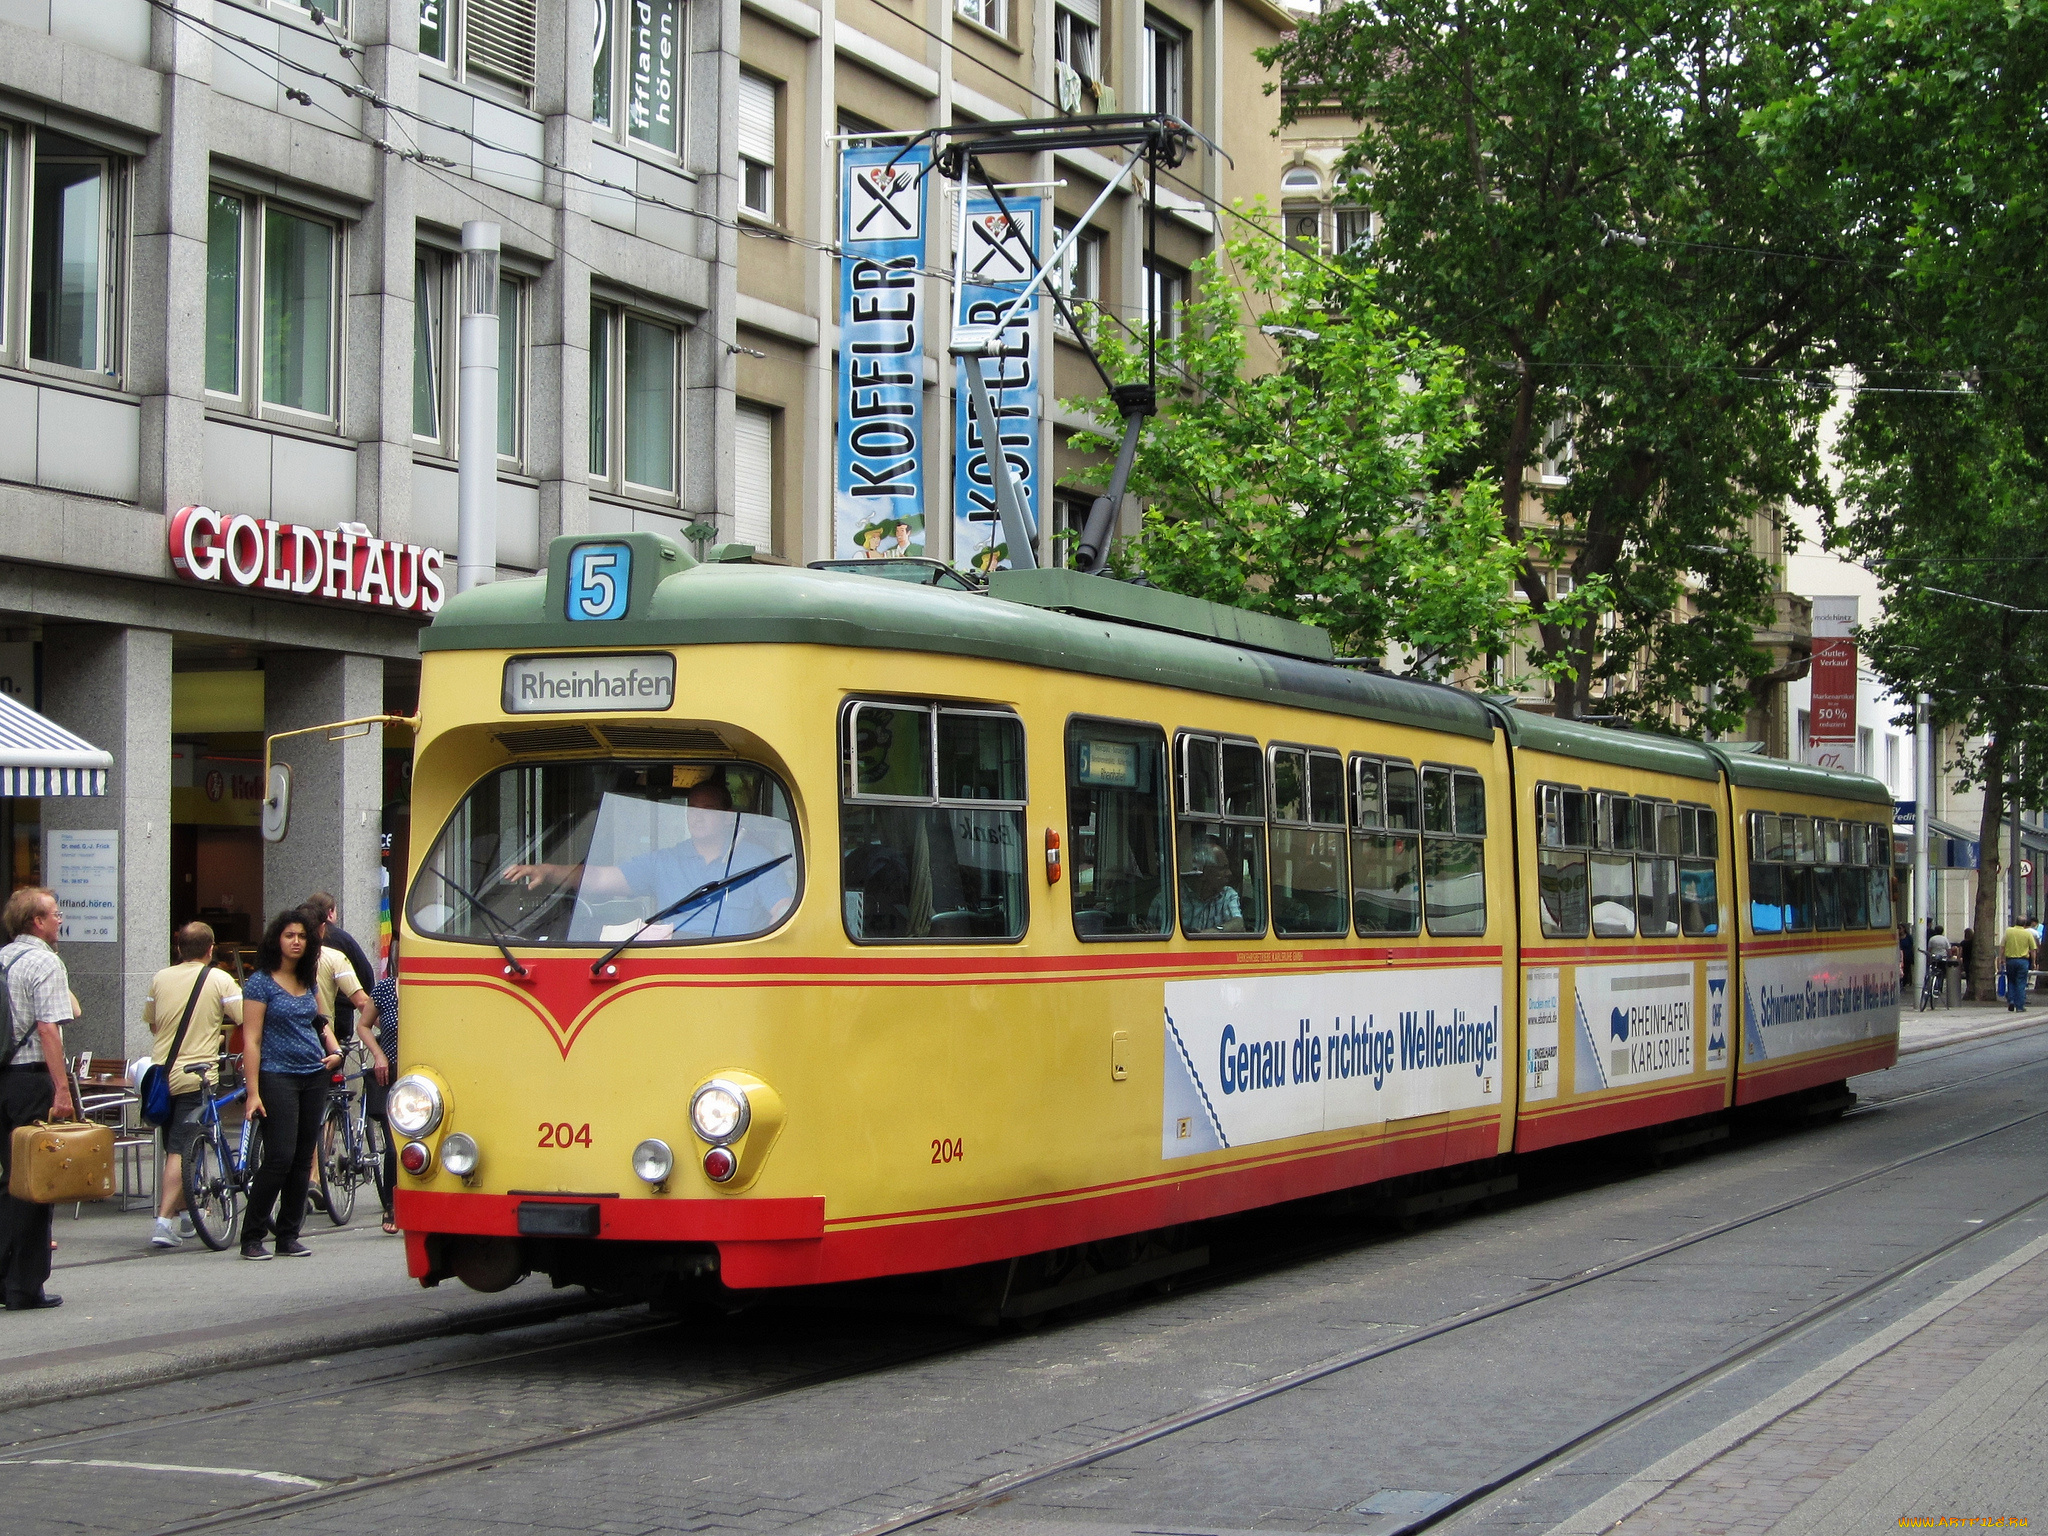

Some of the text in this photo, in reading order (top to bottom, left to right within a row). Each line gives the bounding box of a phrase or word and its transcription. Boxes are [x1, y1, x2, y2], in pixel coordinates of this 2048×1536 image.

[635, 1, 651, 128] iffland
[656, 2, 673, 125] hören.
[850, 256, 917, 497] KOFFLER
[184, 506, 445, 612] GOLDHAUS
[580, 553, 617, 617] 5
[521, 668, 671, 699] Rheinhafen
[60, 900, 115, 908] iffland.hören.
[1631, 1002, 1690, 1037] RHEINHAFEN
[1761, 984, 1804, 1027] Schwimmen
[1806, 979, 1817, 1019] Sie
[1817, 979, 1829, 1017] mit
[1220, 1005, 1498, 1095] Genau die richtige Wellenlänge!
[1631, 1036, 1690, 1074] KARLSRUHE
[537, 1122, 593, 1148] 204
[931, 1137, 964, 1164] 204
